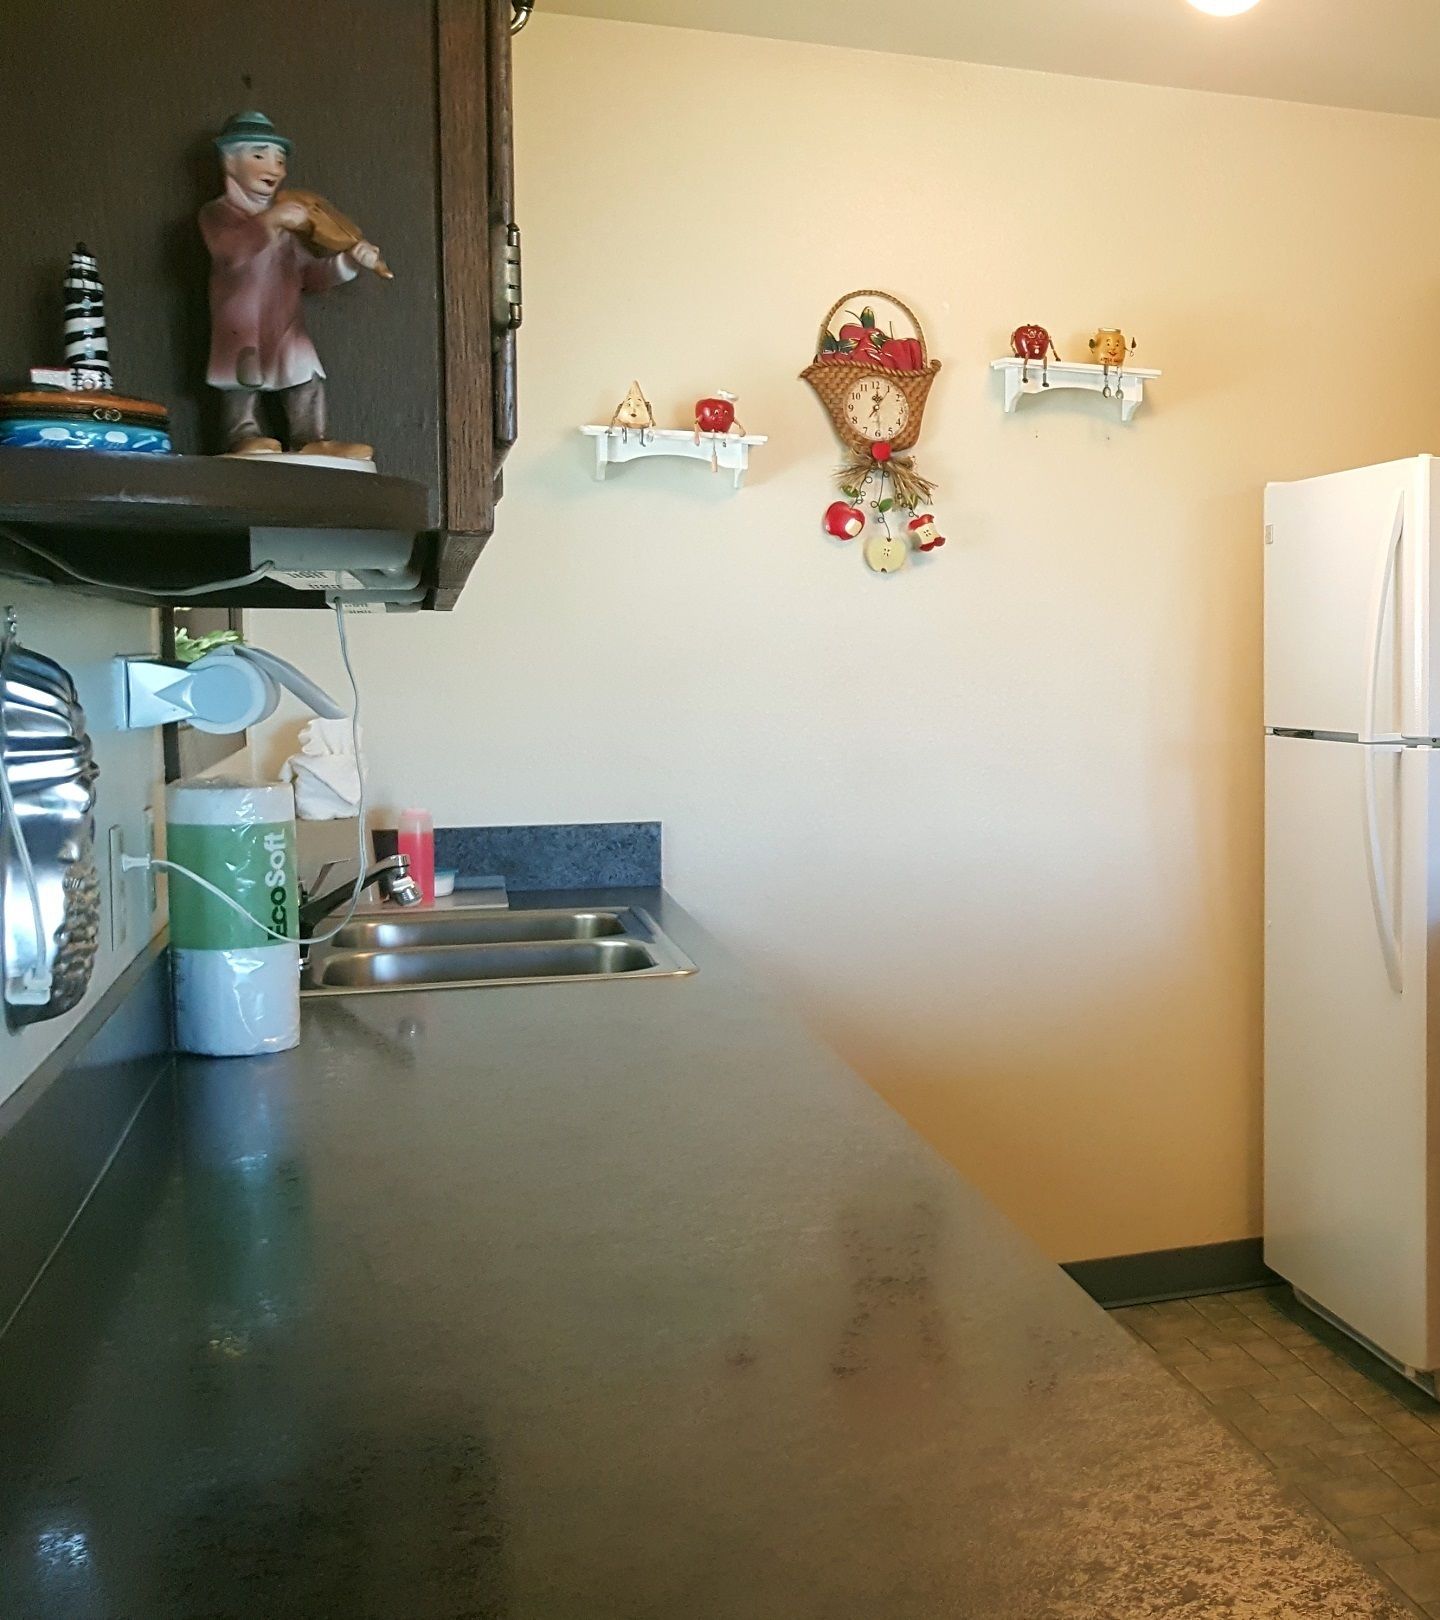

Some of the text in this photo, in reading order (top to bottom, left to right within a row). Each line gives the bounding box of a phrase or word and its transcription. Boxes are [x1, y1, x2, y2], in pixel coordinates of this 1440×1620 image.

[860, 384, 868, 392] 11
[871, 381, 880, 389] 12
[851, 392, 861, 400] 10
[848, 404, 854, 412] 9
[898, 407, 904, 415] 3
[851, 416, 858, 424] 8
[895, 418, 901, 426] 4
[862, 426, 868, 434] 7
[887, 427, 893, 435] 5
